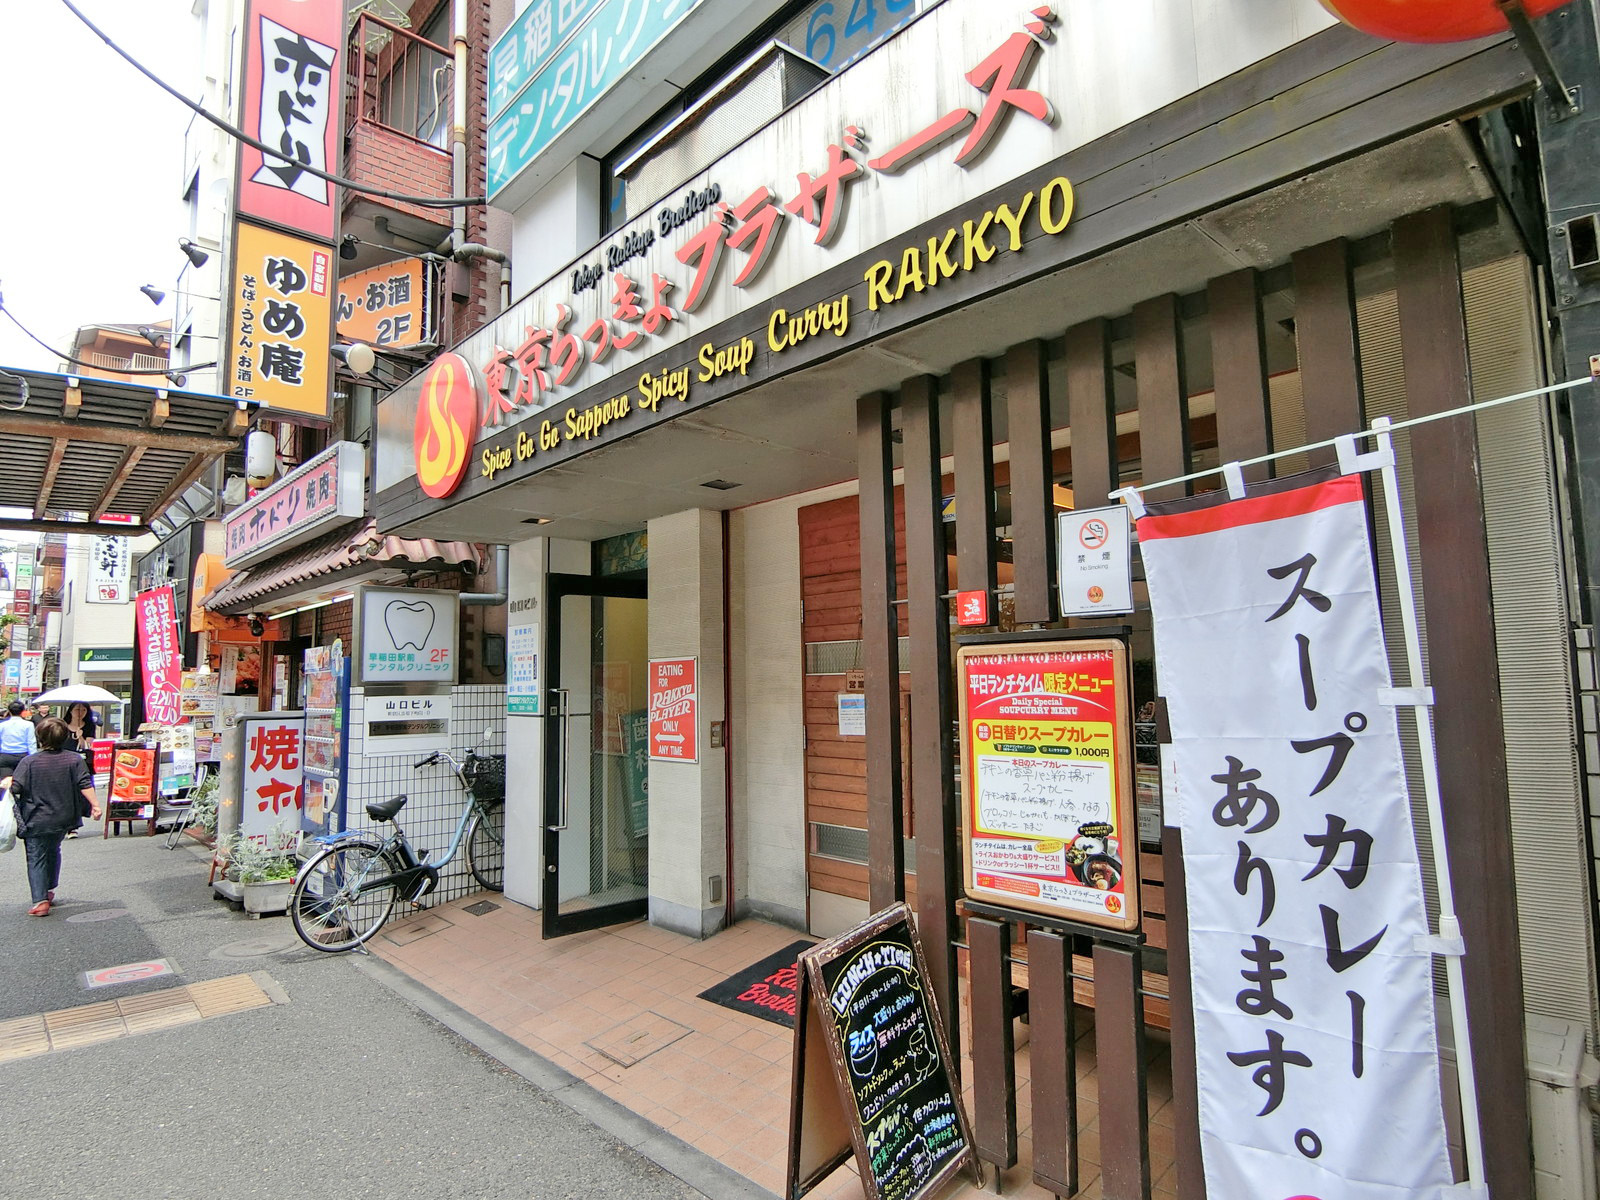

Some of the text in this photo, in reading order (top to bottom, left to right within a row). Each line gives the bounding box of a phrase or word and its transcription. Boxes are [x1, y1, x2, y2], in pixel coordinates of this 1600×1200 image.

[481, 5, 1057, 428] 東京らっきょブラザーズ
[571, 182, 722, 295] Tokyo Rakkyo Brothers
[260, 256, 307, 386] ゆめ庵
[376, 312, 413, 345] 2F
[482, 176, 1075, 480] Spice Go Go Sapporo Spicy Soup Curry RAKKYO
[235, 386, 254, 397] 2F
[1088, 563, 1109, 571] Smoking
[510, 597, 538, 613] 山口ビル
[369, 652, 415, 662] 早稲田駅前
[430, 648, 449, 663] 2F
[8, 666, 18, 677] P
[368, 663, 450, 672] デンタルクリニック
[658, 664, 683, 677] EATING
[658, 678, 668, 687] FOR
[969, 672, 1113, 695] 平日ランチタイム限定メニュー
[651, 683, 693, 711] RAKKYO
[1011, 697, 1063, 706] Daily Special
[385, 700, 433, 710] 山口ビル
[650, 700, 691, 723] PLAYER
[999, 706, 1078, 715] SOUPCURRY MENU
[662, 720, 679, 732] ONLY
[992, 724, 1109, 743] 日替りスープカレー
[658, 745, 683, 756] ANY TIME
[1075, 747, 1110, 757] 1,000円
[1011, 758, 1069, 769] 本日のスープカレー
[1264, 552, 1389, 1080] スープカレー
[1041, 883, 1103, 900] 東京らっきょブラザーズ
[1209, 755, 1325, 1160] あります。
[832, 945, 911, 1015] LUNCH TIME
[849, 1024, 876, 1055] ライス
